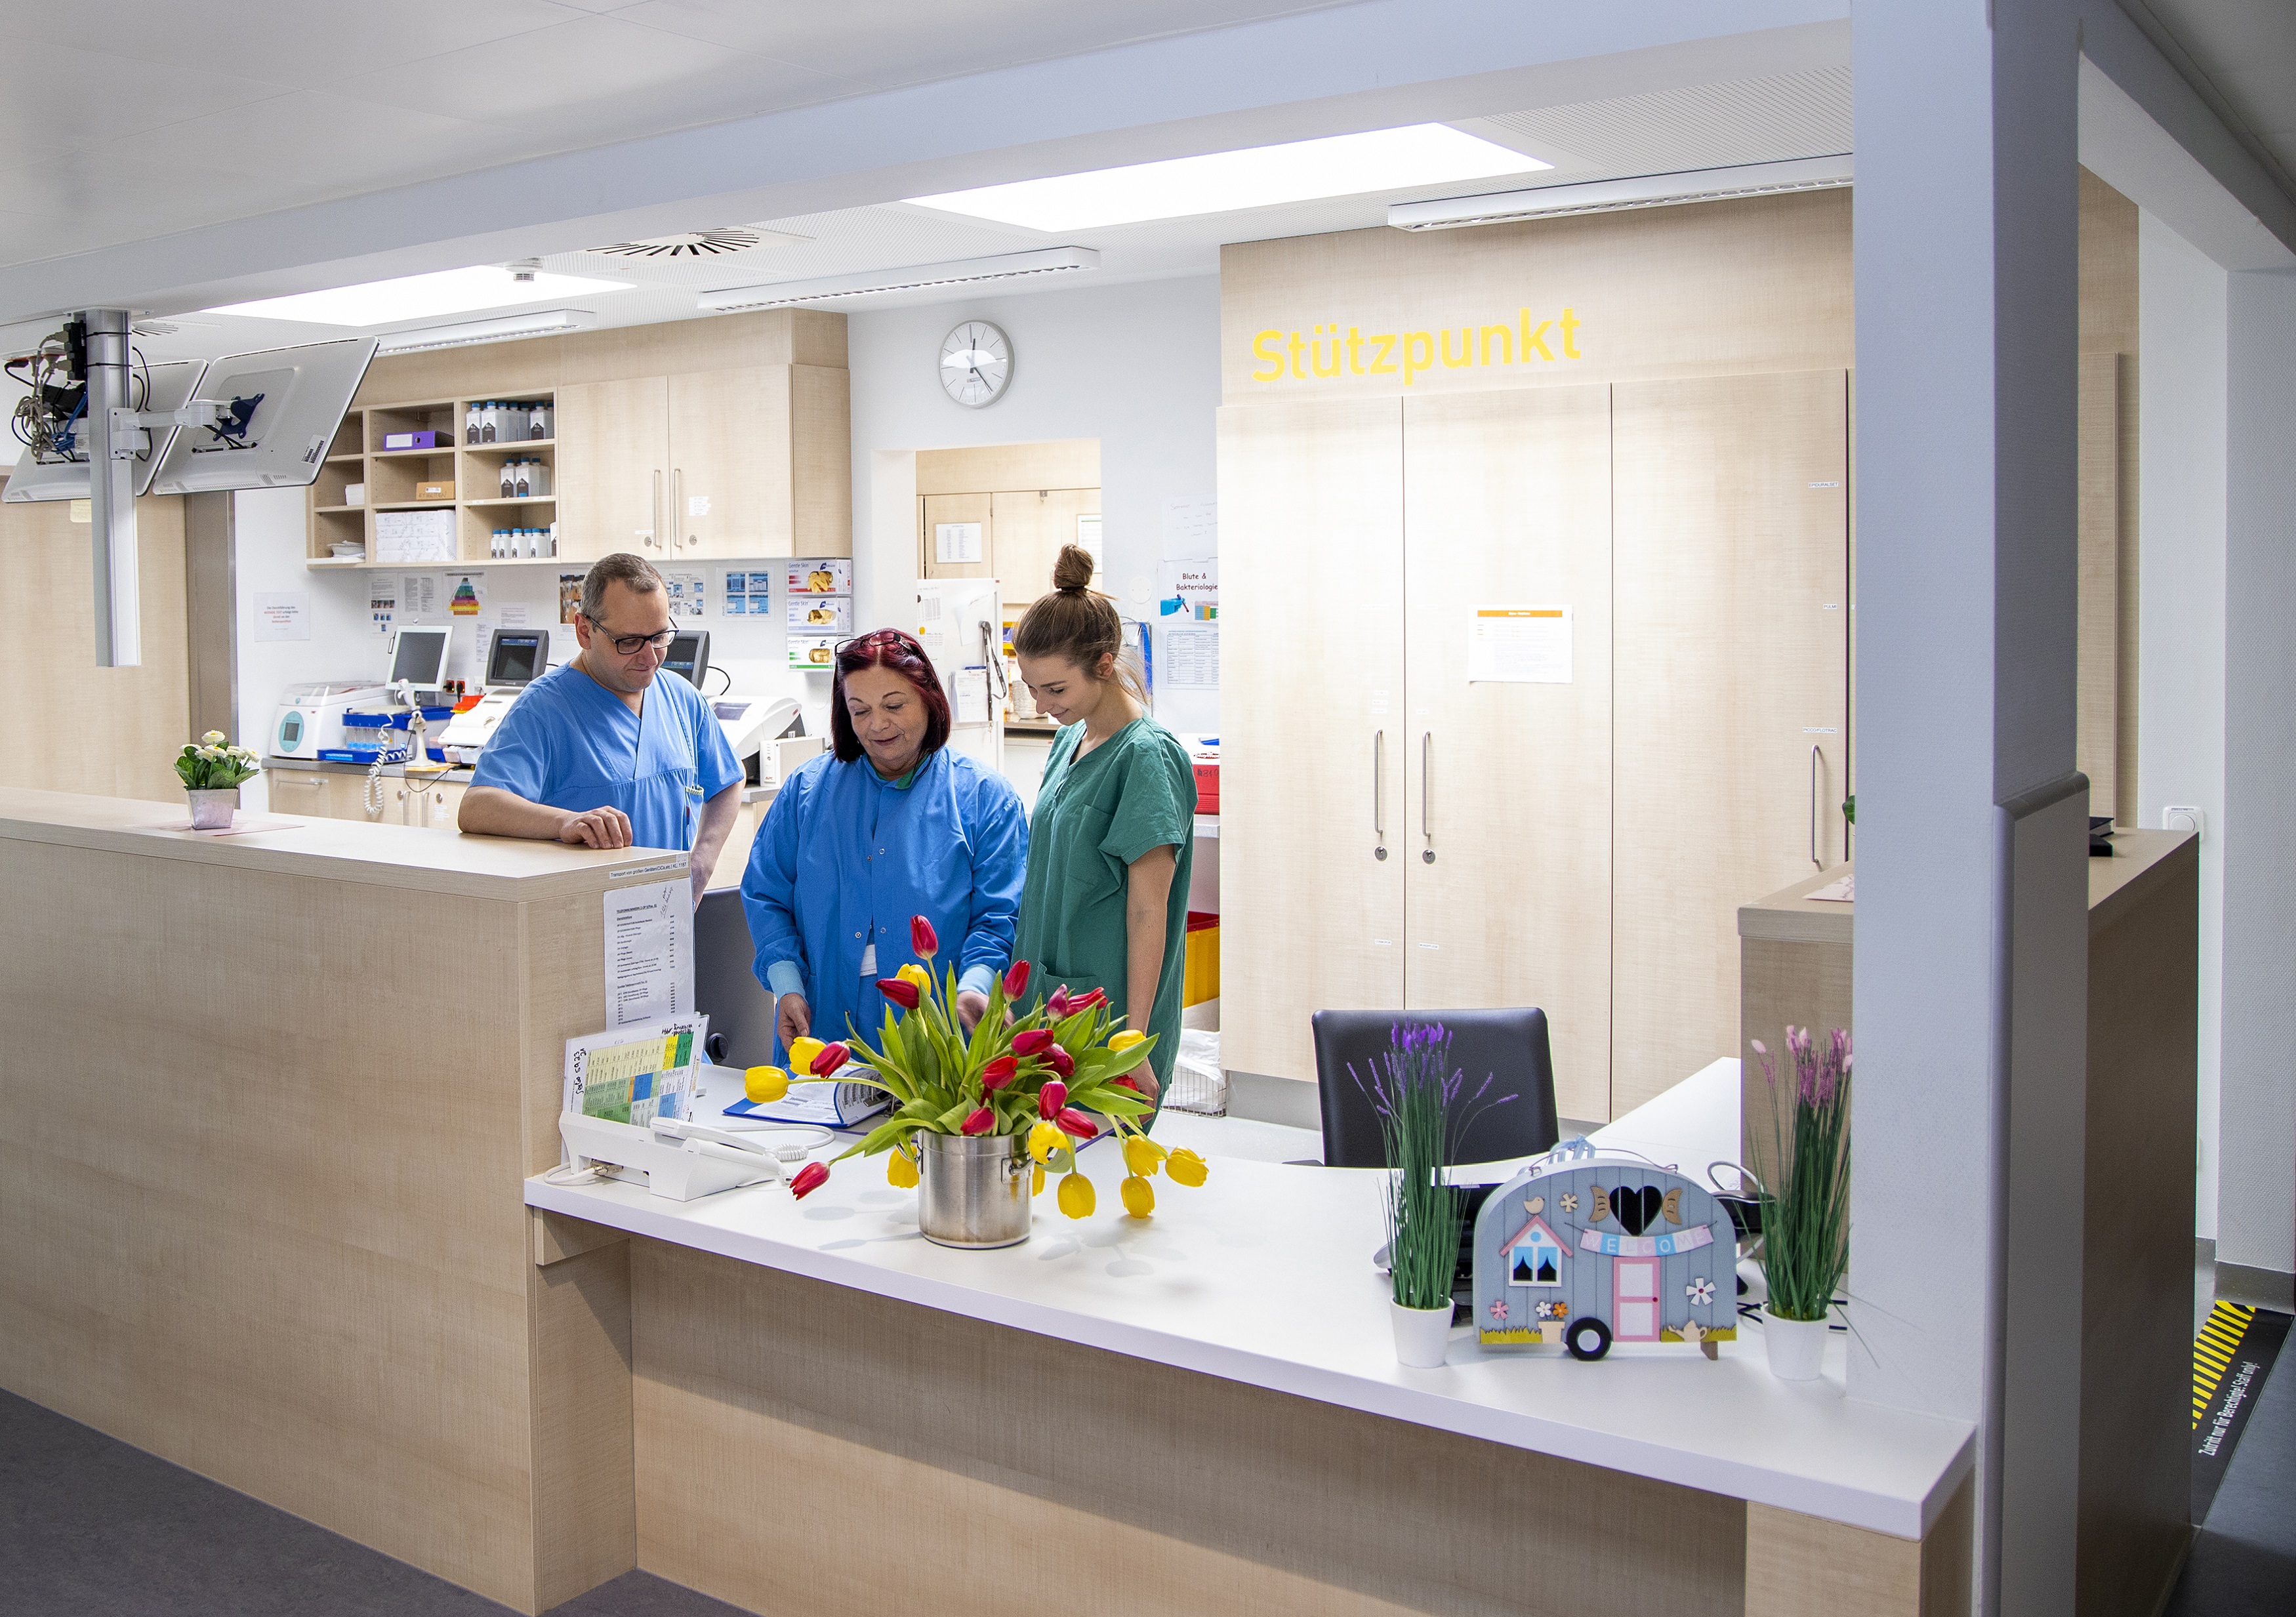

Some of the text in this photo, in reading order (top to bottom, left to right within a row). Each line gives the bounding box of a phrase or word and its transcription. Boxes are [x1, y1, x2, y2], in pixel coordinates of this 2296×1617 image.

[1252, 308, 1581, 385] Stützpunkt
[1584, 1231, 1707, 1253] WELCOME
[2198, 1362, 2260, 1456] Zutritt nur für Berechtigte! Staff only!
